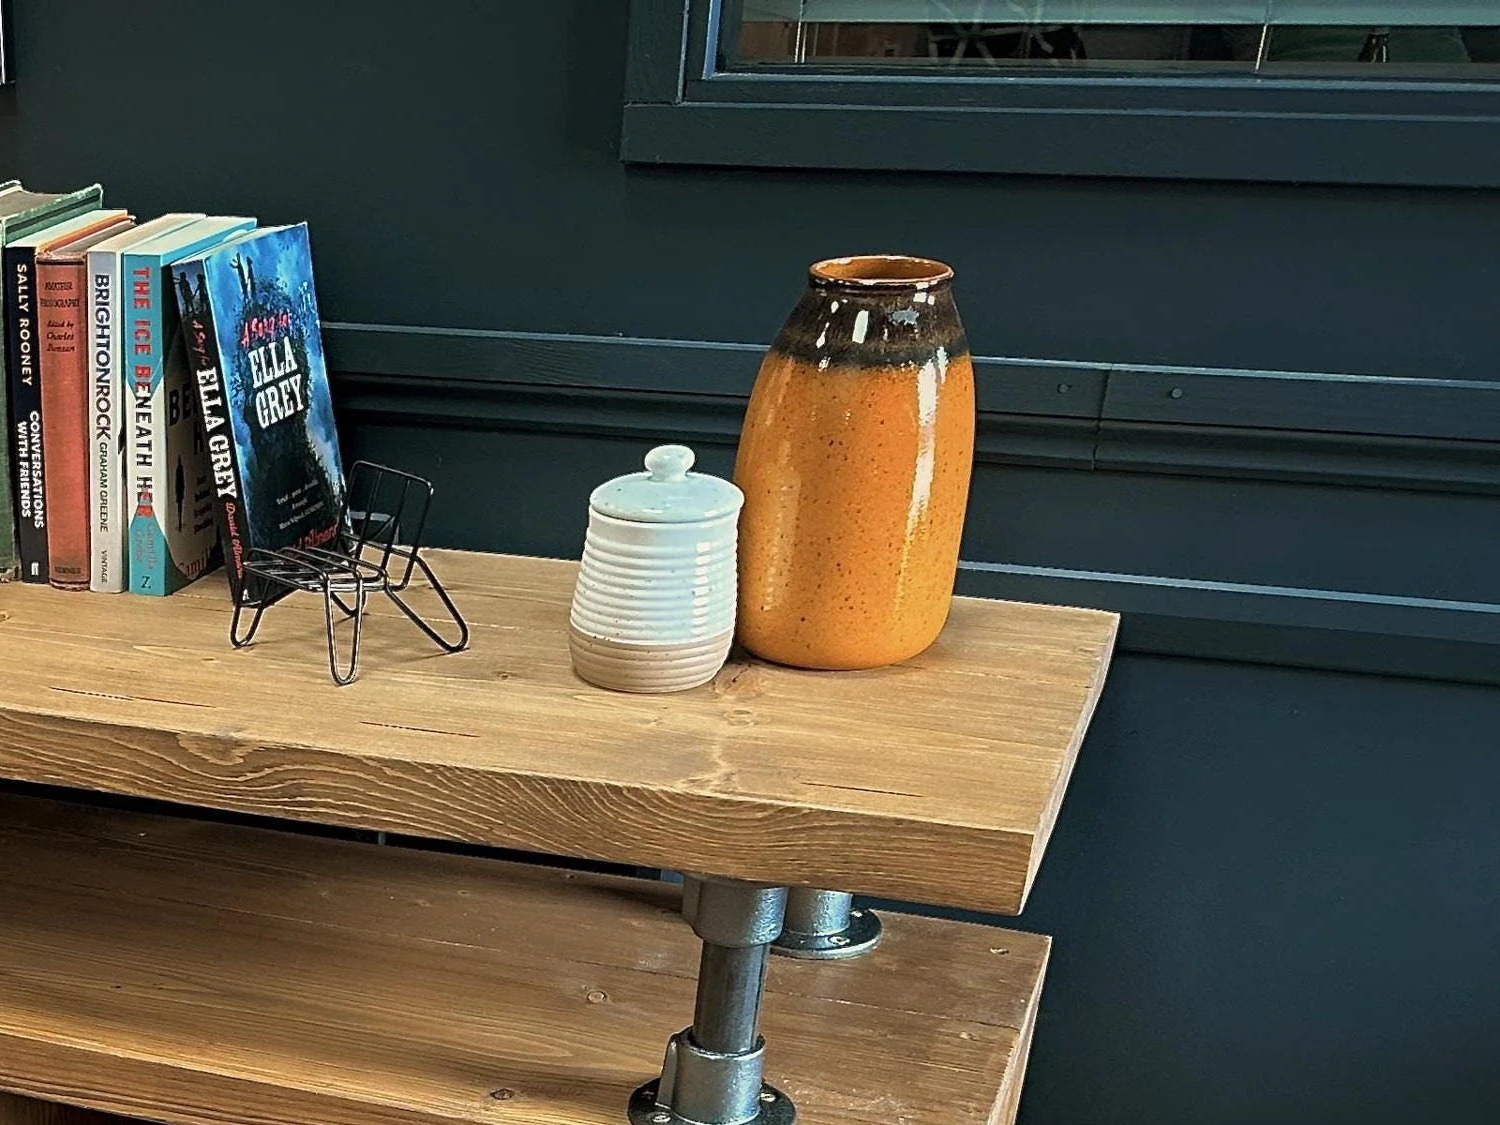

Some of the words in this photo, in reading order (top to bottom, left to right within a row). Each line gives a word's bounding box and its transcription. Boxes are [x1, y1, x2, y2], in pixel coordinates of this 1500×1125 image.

[16, 263, 29, 312] SALLY
[133, 267, 151, 309] THE
[19, 318, 33, 386] ROONEY
[134, 320, 152, 355] ICE
[248, 336, 298, 389] ELLA
[135, 365, 153, 467] BENEATH
[197, 366, 226, 432] ELLA
[255, 374, 305, 430] GREY
[17, 420, 29, 458] WITH
[99, 441, 109, 488] GRAHAM
[18, 461, 32, 518] FRIENDS
[29, 410, 45, 529] CONVERSATIONS
[208, 433, 238, 499] GREY
[99, 488, 109, 533] GREENE
[101, 550, 109, 584] VINTAGE
